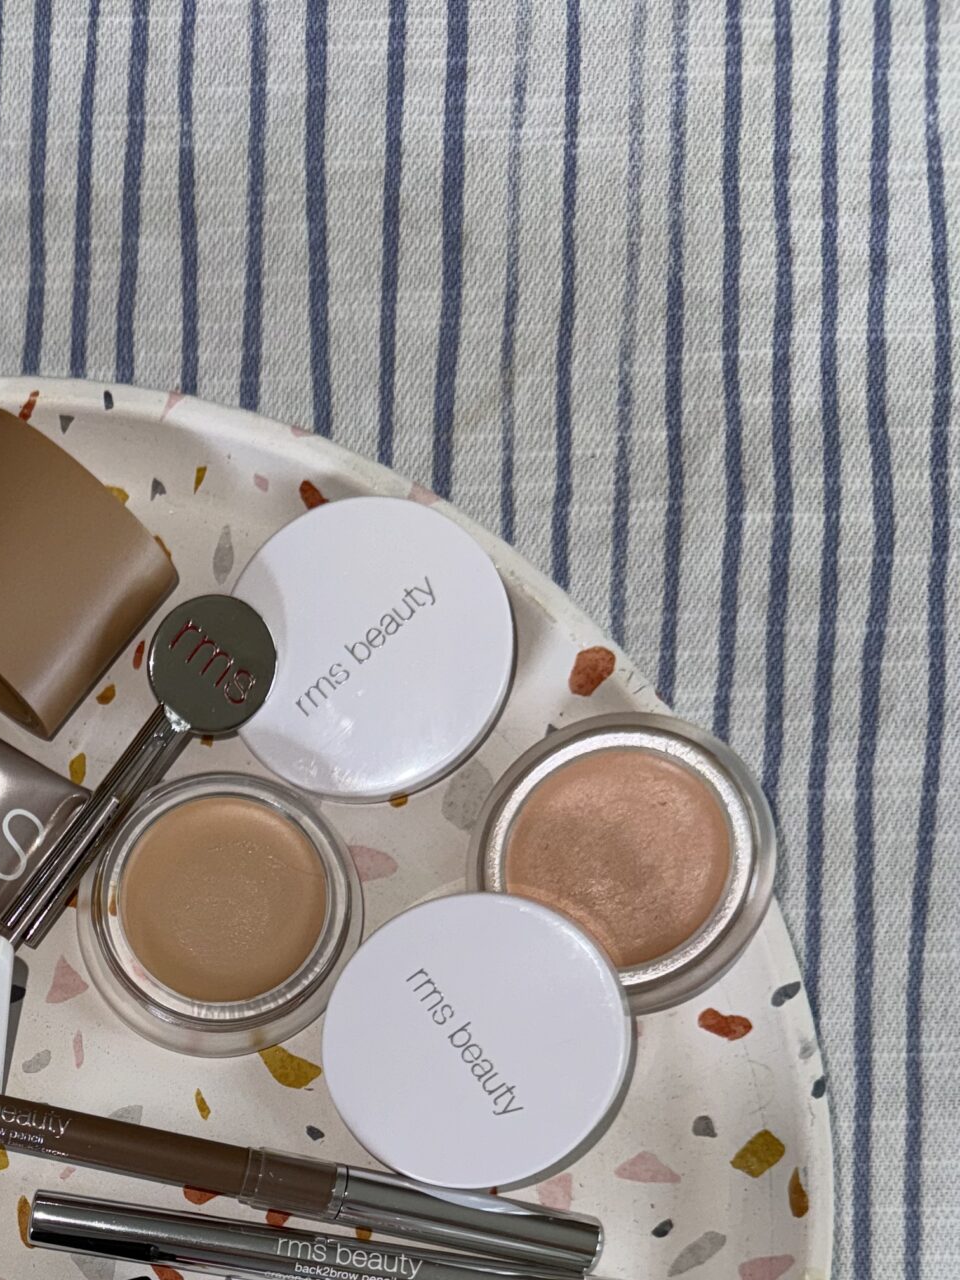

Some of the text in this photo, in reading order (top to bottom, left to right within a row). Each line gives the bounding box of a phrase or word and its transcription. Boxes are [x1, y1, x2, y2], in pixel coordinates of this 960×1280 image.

[168, 617, 257, 705] rms
[294, 575, 437, 718] rms beauty
[406, 967, 525, 1116] rms beauty
[276, 1237, 424, 1280] rms beauty
[294, 1262, 359, 1280] back2brow
